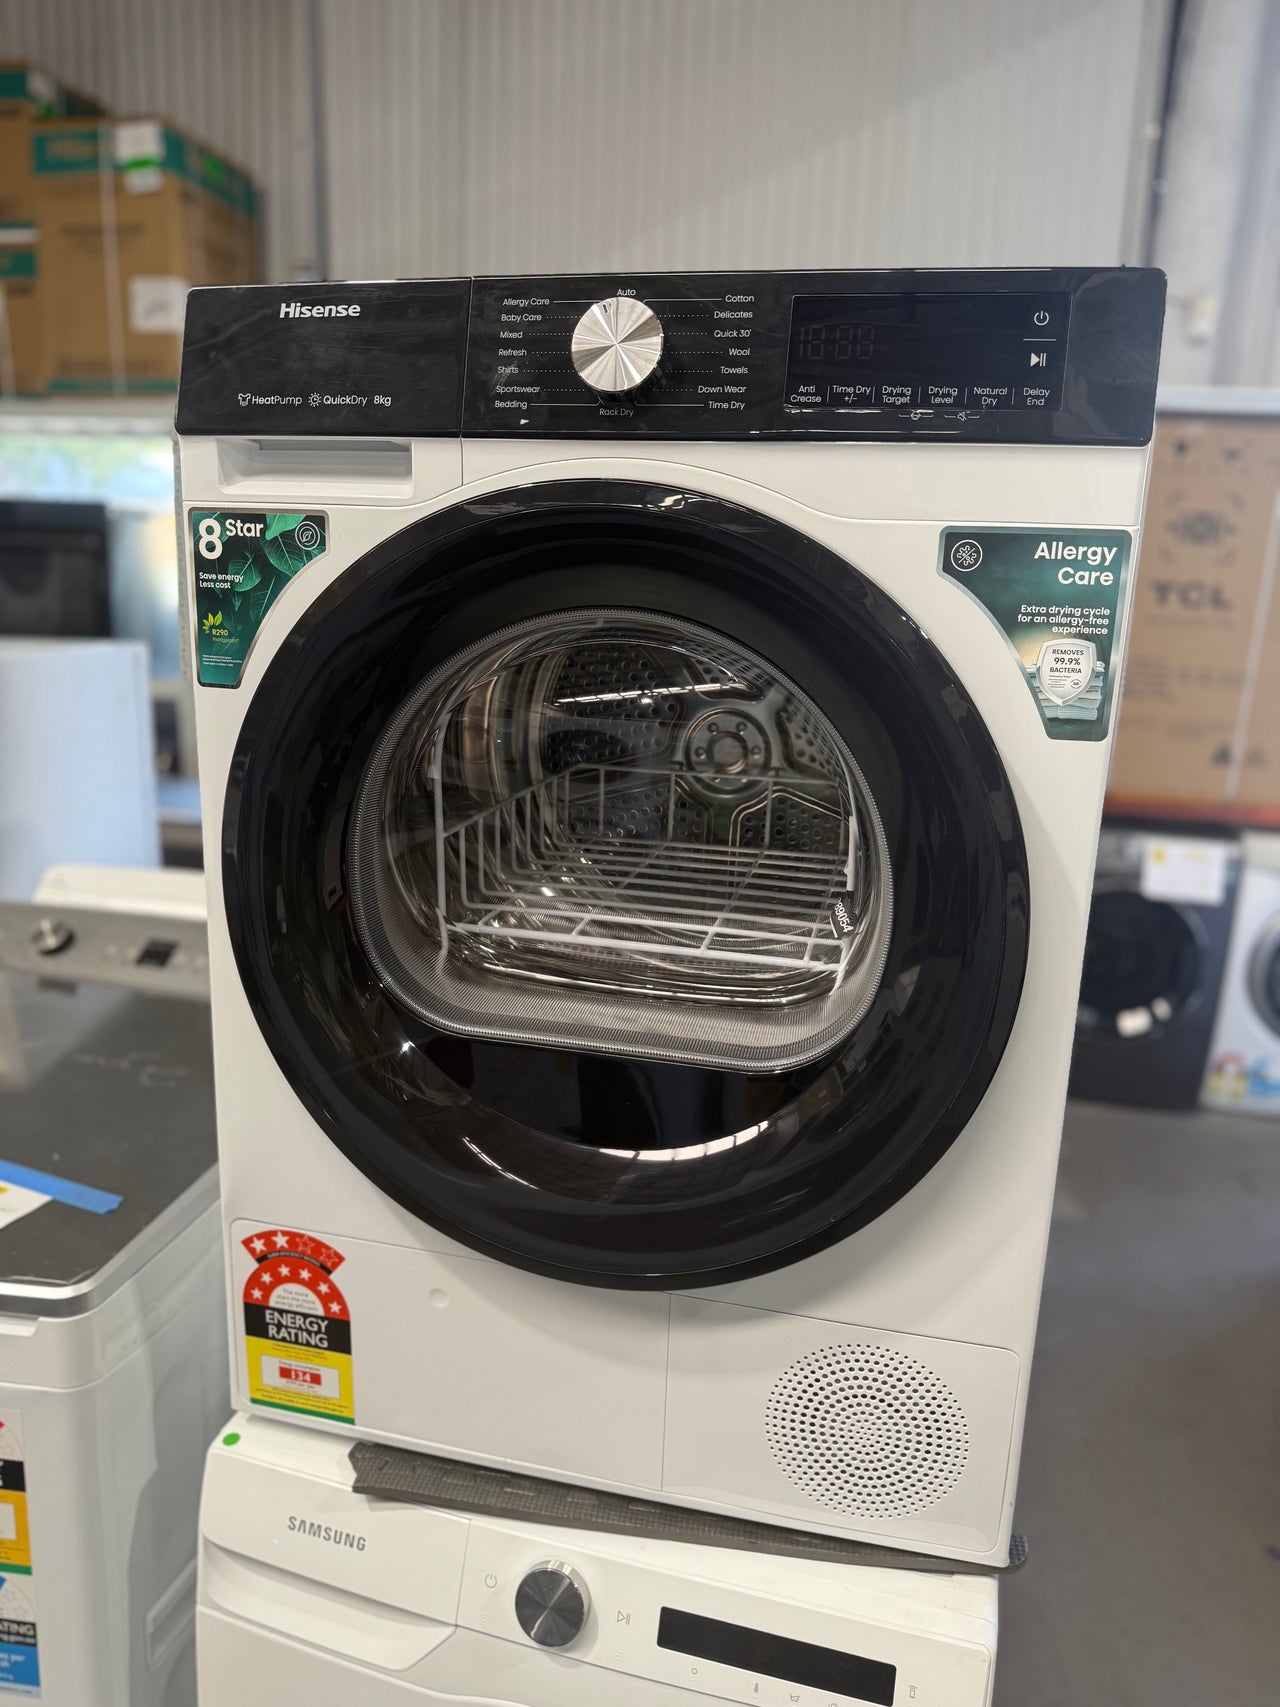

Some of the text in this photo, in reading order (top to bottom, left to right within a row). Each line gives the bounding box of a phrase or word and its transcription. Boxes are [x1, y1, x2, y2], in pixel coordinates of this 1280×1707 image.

[616, 288, 636, 297] Auto
[502, 297, 550, 307] Allergy Care
[725, 294, 755, 303] Cotton
[279, 303, 361, 318] Hisense
[713, 310, 753, 319] Delicates
[501, 313, 542, 323] Baby Care
[499, 330, 523, 339] Mixed
[713, 329, 738, 338] Quick
[498, 348, 527, 357] Refresh
[728, 347, 751, 356] Wool
[497, 365, 519, 374] Shirts
[720, 365, 749, 374] Towels
[496, 385, 541, 395] Sportswear
[697, 385, 747, 394] Down Wear
[798, 384, 816, 393] Anti
[832, 384, 872, 396] Time Dry
[882, 385, 912, 396] Drying
[928, 386, 958, 397] Drying
[973, 386, 1008, 396] Natural
[1023, 387, 1051, 398] Delay
[252, 394, 302, 407] HeatPump
[323, 394, 368, 407] QuickDry
[373, 395, 392, 407] 8kg
[790, 394, 822, 403] Crease
[882, 395, 911, 405] Target
[931, 396, 954, 404] Level
[981, 397, 998, 407] Dry
[1026, 397, 1045, 406] End
[494, 400, 528, 410] Bedding
[708, 401, 746, 411] Time Dry
[599, 408, 634, 418] Rack Dry
[225, 518, 264, 538] Star
[198, 518, 223, 560] 8
[1034, 541, 1118, 566] Allergy
[199, 572, 244, 583] Save energy
[1057, 566, 1114, 586] Care
[199, 581, 231, 589] Less cost
[1153, 579, 1230, 611] TCL
[1021, 604, 1111, 617] Extra drying cycle
[1017, 614, 1110, 626] for an allergy-free
[211, 628, 229, 636] R290
[1051, 625, 1109, 636] experience
[1053, 657, 1081, 667] 99.9%
[265, 1309, 329, 1333] ENERGY
[268, 1324, 328, 1348] RATING
[291, 1370, 311, 1383] 134
[287, 1515, 367, 1552] SAMSUNG
